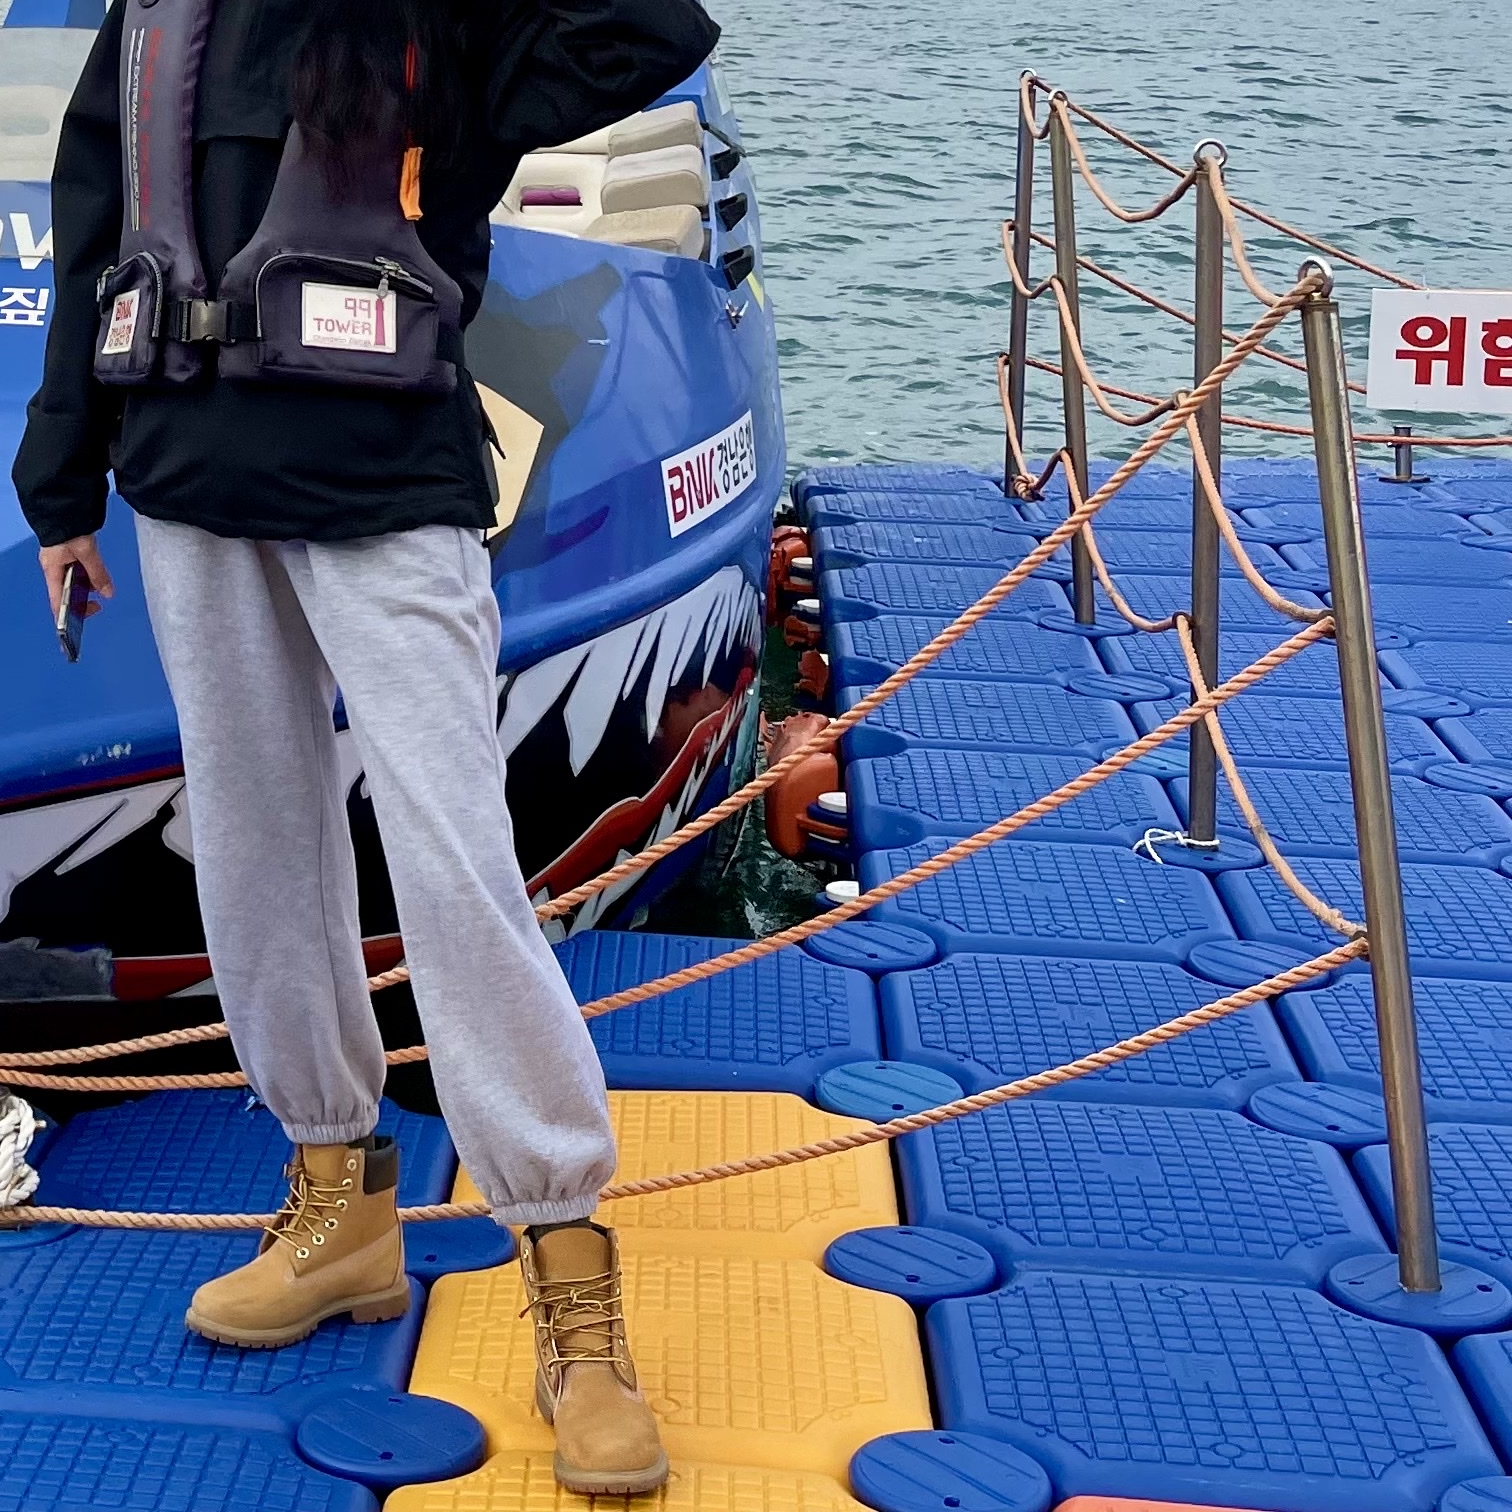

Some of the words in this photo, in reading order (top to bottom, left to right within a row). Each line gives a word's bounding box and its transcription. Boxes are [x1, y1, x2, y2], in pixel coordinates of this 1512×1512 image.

[344, 298, 371, 318] 99
[313, 318, 372, 335] TOWER
[667, 447, 720, 524] BNK
